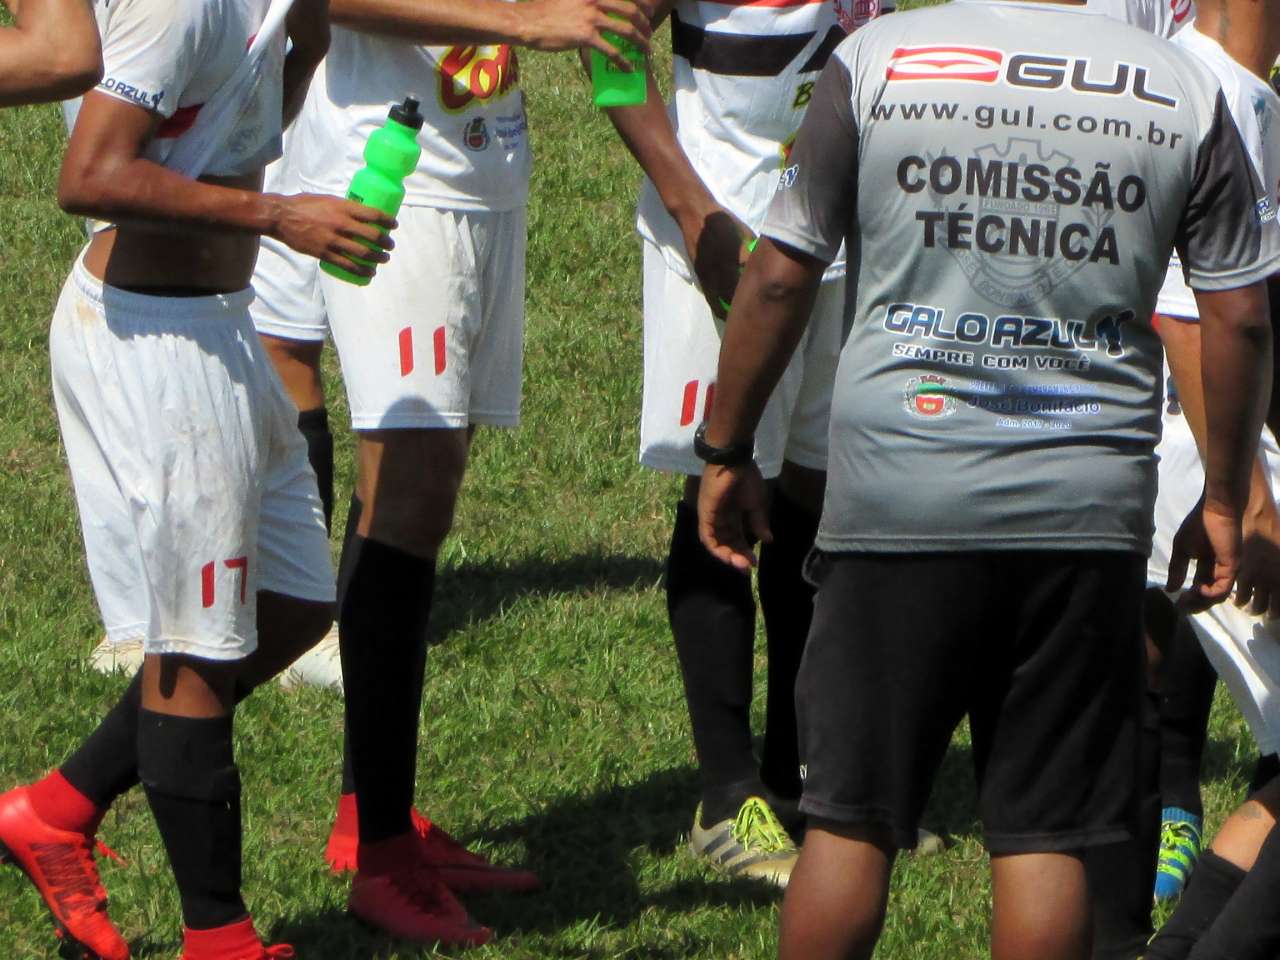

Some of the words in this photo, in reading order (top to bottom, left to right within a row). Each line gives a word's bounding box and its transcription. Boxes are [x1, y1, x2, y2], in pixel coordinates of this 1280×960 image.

[1004, 53, 1178, 111] GUL
[871, 101, 1183, 151] www.gul.com.br
[896, 155, 1147, 213] COMISSÃO
[915, 201, 1121, 266] TÉCNICA
[399, 325, 447, 378] 11
[883, 302, 989, 346] GALO
[990, 314, 1099, 352] AZUL
[892, 343, 975, 367] SEMPRE
[982, 352, 1029, 370] COM
[1035, 352, 1092, 372] VOCÊ
[200, 555, 249, 609] 17
